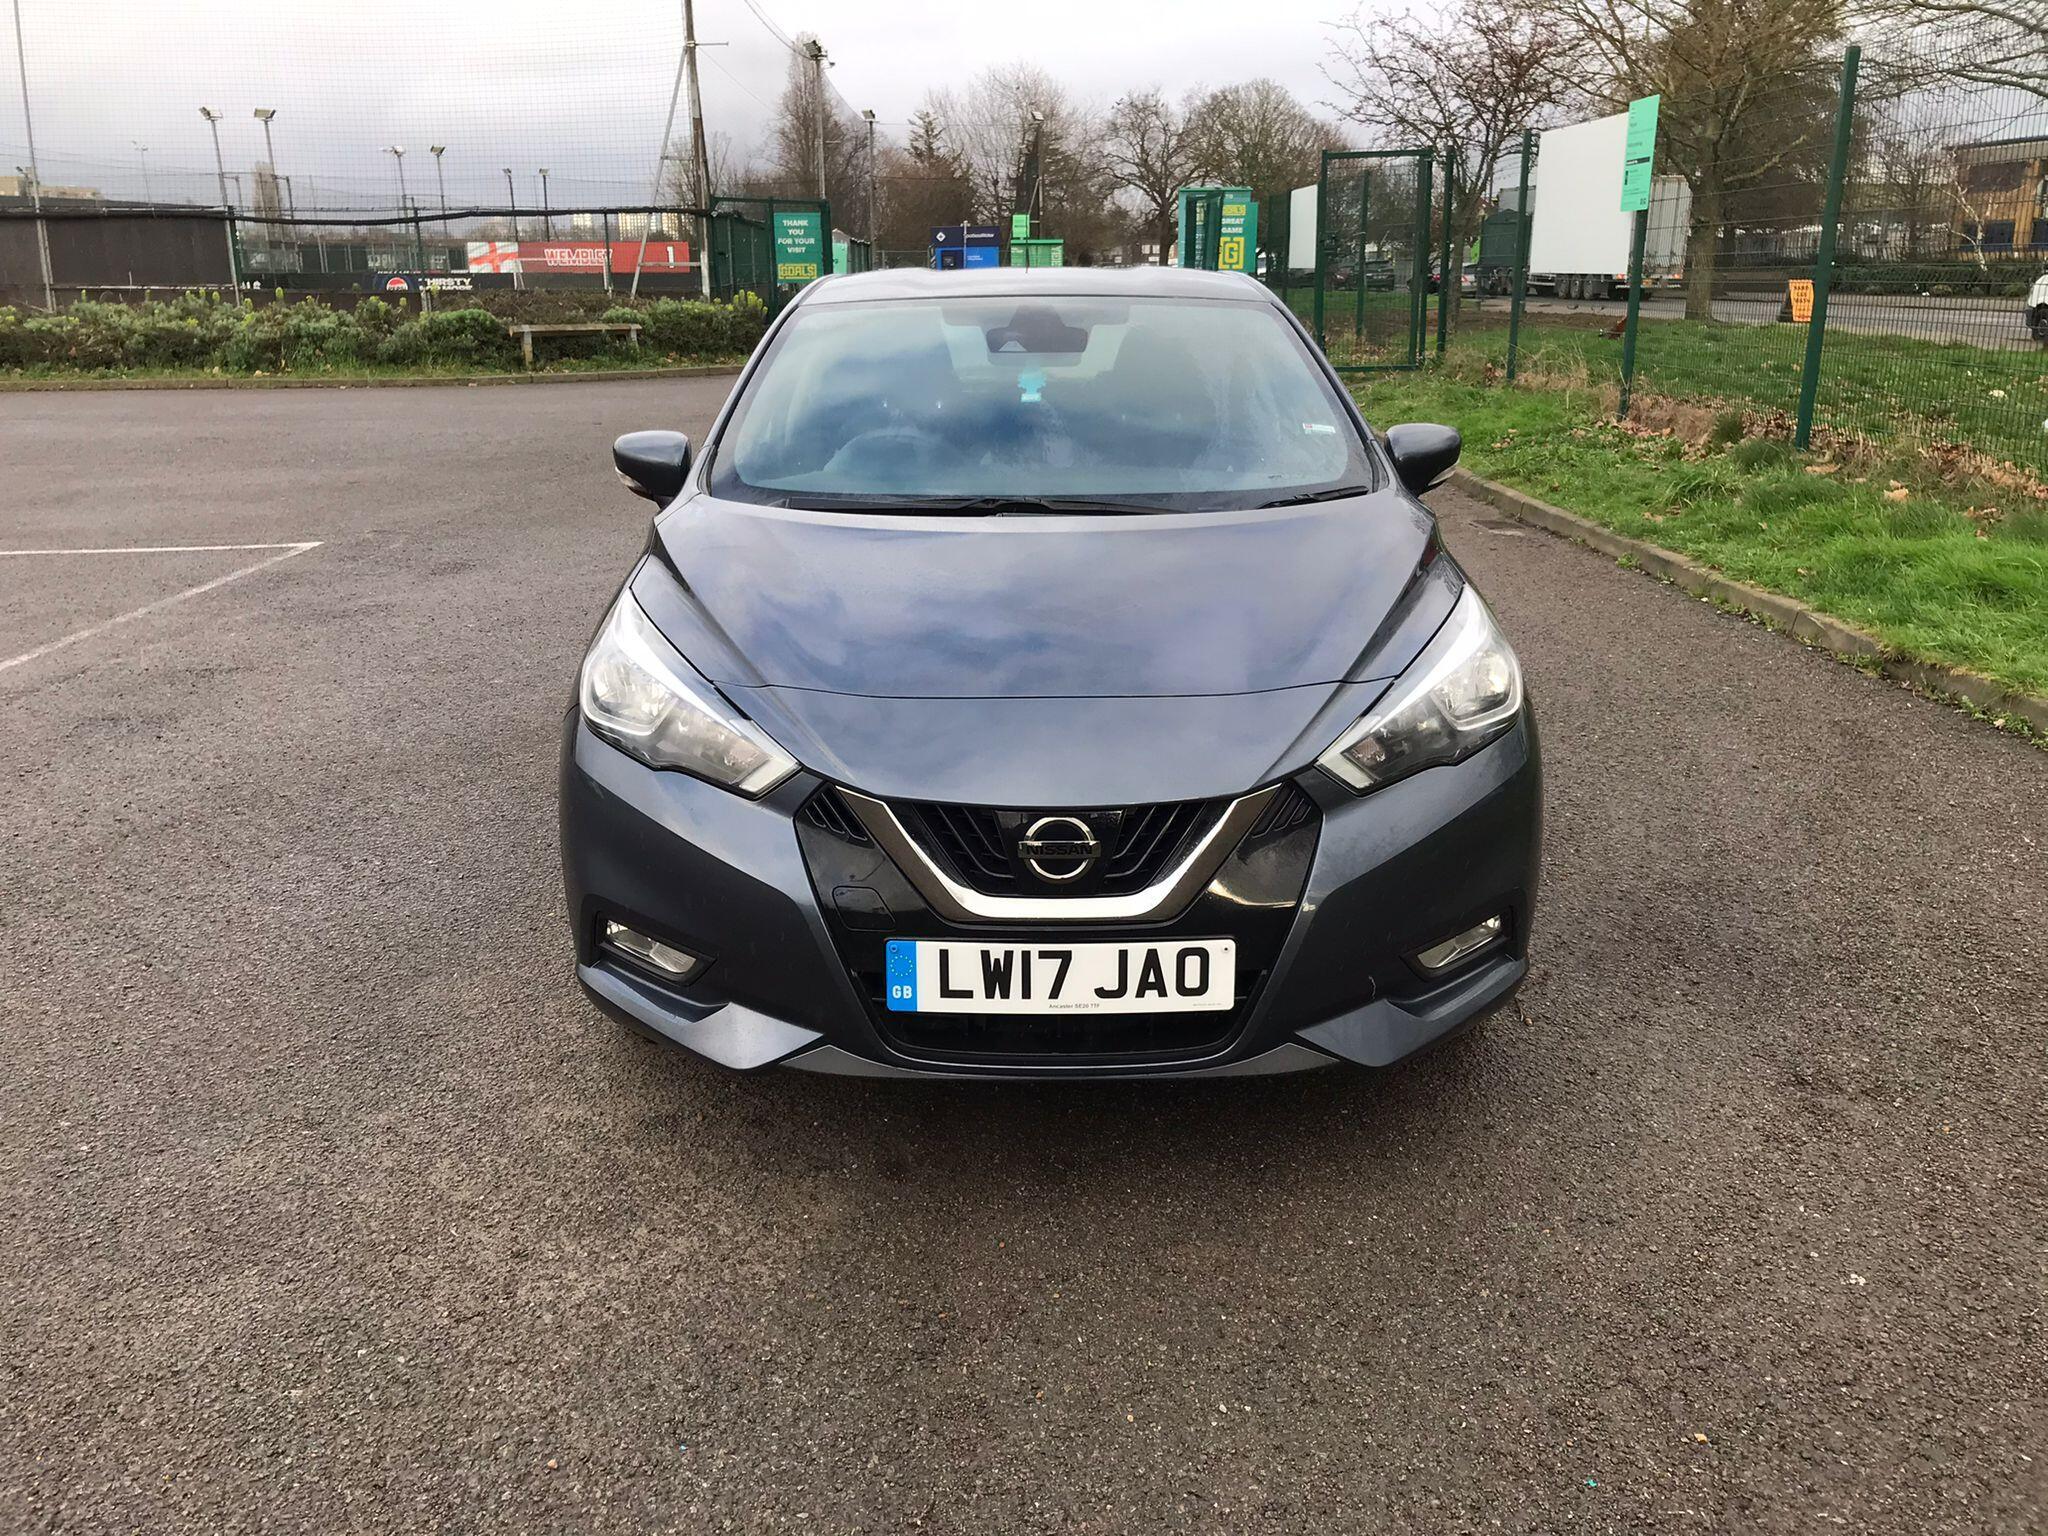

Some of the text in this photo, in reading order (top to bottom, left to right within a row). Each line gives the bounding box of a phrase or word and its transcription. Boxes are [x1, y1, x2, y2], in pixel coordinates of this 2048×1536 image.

[782, 219, 809, 227] THANK
[779, 264, 816, 279] GOALS
[1026, 844, 1093, 856] NISSAN
[938, 946, 1210, 1000] LW17 JAO
[891, 985, 912, 999] GB
